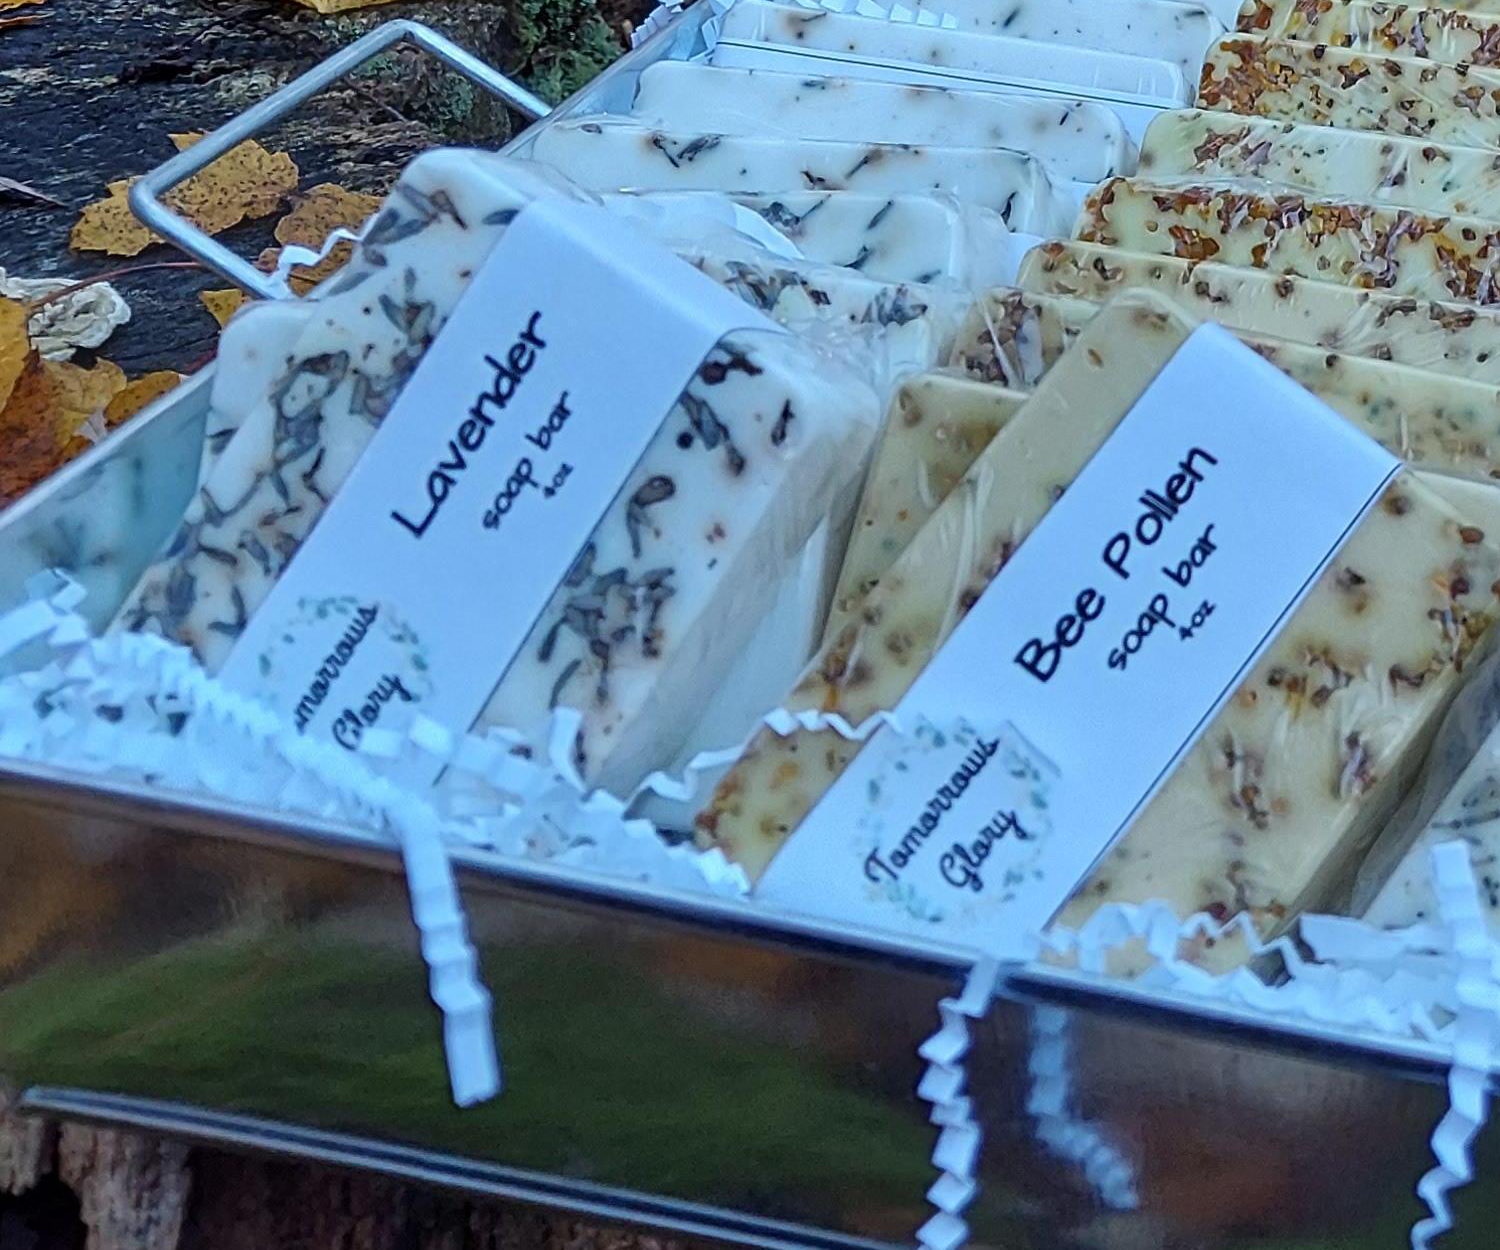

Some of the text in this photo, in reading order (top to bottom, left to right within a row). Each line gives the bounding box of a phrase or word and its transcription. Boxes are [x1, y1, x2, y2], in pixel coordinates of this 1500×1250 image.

[390, 310, 549, 538] Lavender
[482, 390, 575, 532] soap bar
[1013, 446, 1218, 683] Bee Pollen
[1107, 523, 1218, 672] soap bar
[1179, 601, 1217, 641] 4oz
[293, 603, 380, 737] morrows
[864, 737, 1001, 884] Tomorrows
[938, 809, 1034, 893] Glory
